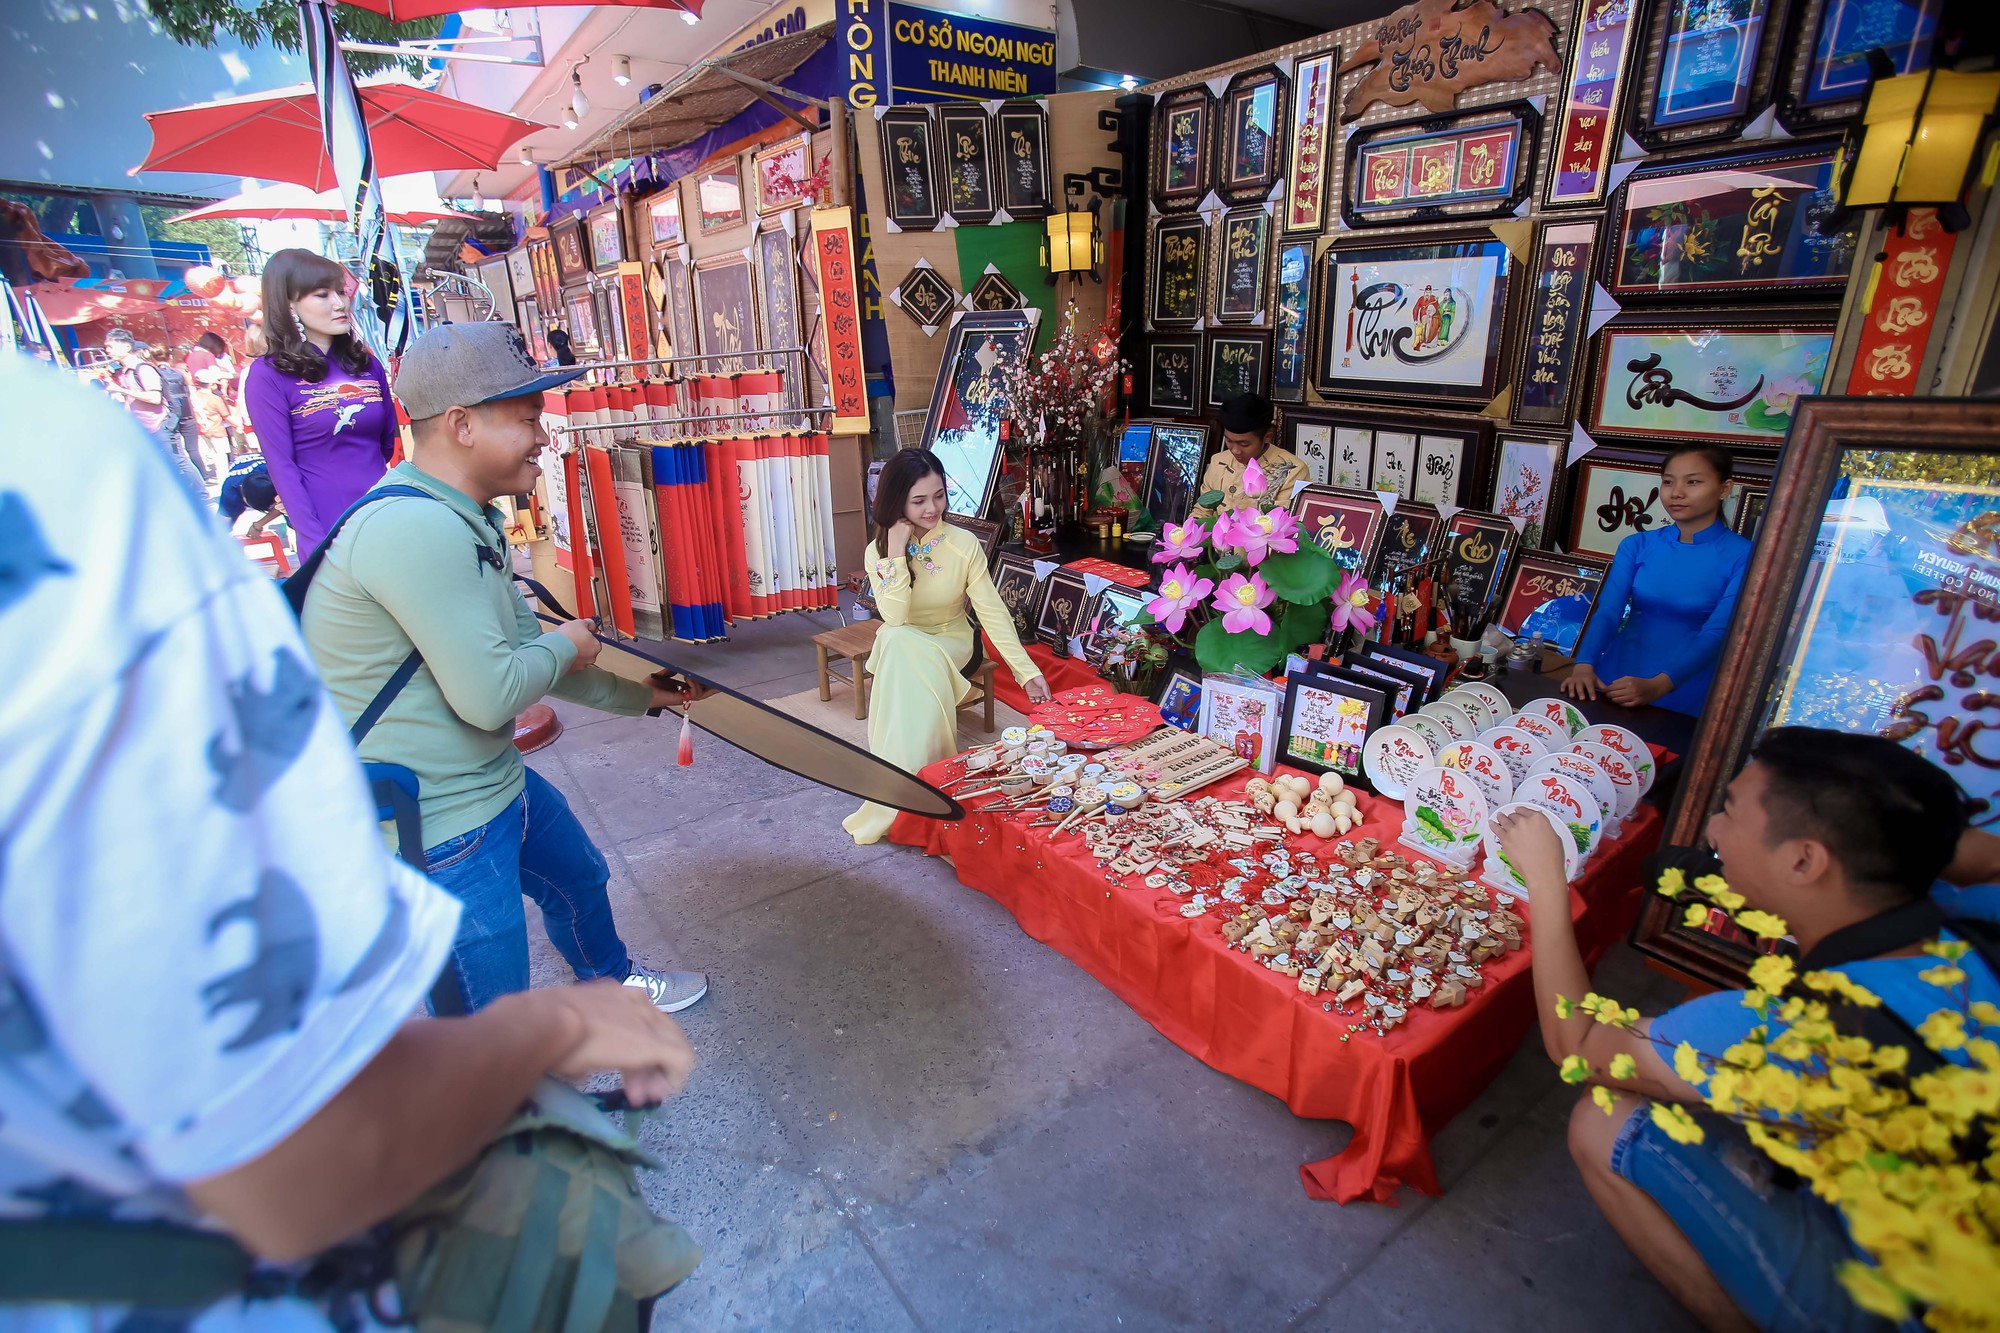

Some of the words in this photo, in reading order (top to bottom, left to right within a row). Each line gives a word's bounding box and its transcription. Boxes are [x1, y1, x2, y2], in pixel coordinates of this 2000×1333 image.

[895, 19, 924, 44] CƠ
[928, 18, 953, 50] SỞ
[956, 30, 1014, 63] NGOẠI
[1016, 40, 1055, 67] NGỮ
[928, 59, 985, 88] THANH
[988, 66, 1028, 94] NIÊN
[1355, 282, 1475, 367] Phúc
